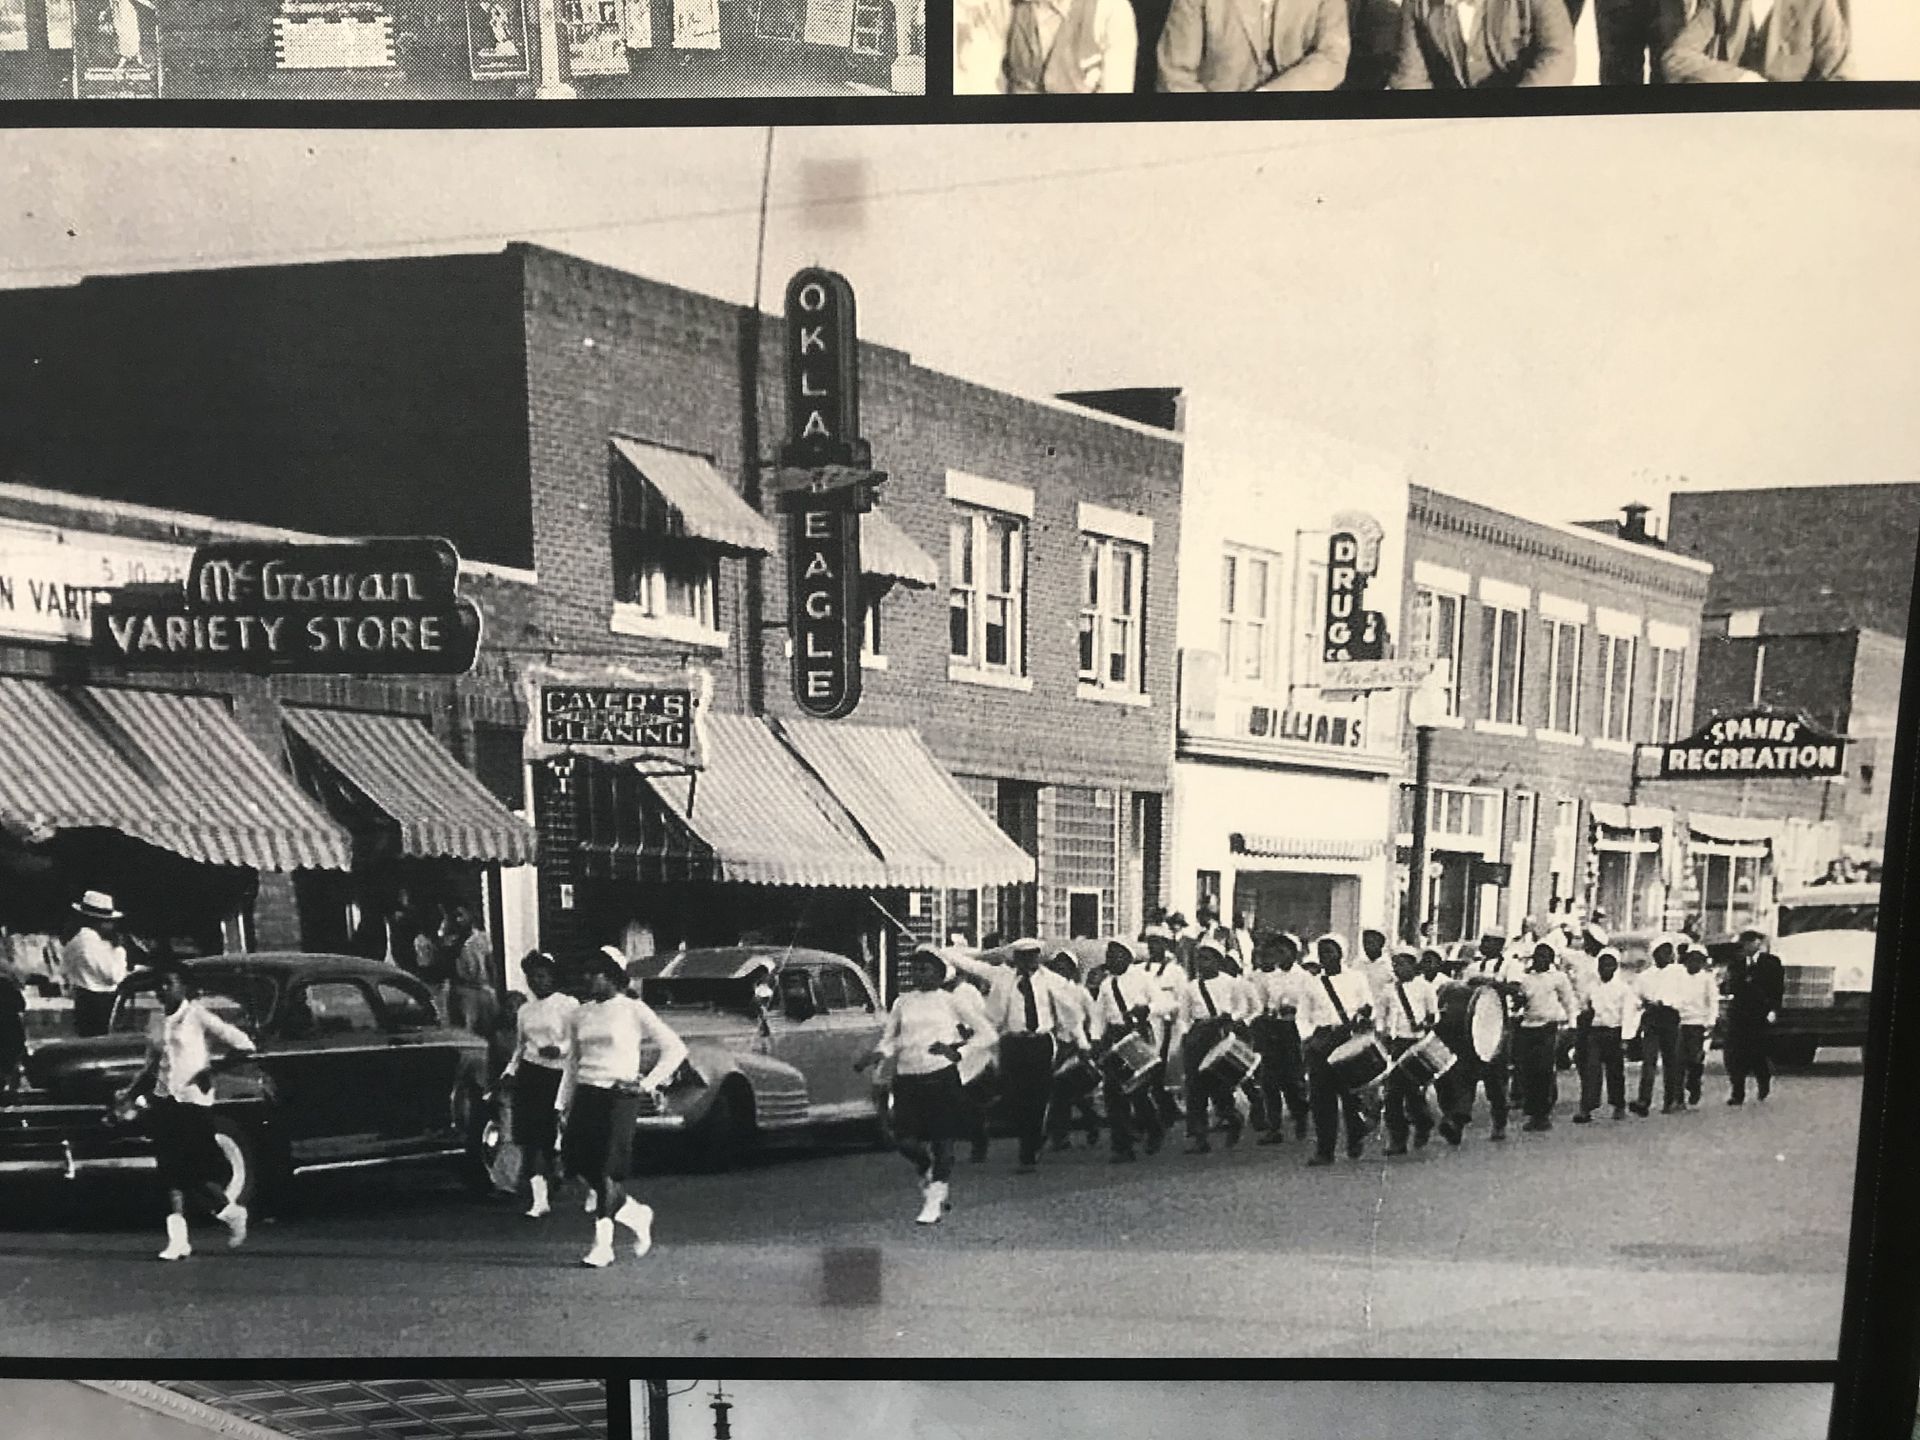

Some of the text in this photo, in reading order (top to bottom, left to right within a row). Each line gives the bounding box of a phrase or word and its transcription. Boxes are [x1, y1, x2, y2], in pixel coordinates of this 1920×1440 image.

[799, 283, 834, 698] OKLA EAGLE
[1327, 540, 1357, 645] DRUG
[107, 615, 441, 655] VARIETY STORE
[1667, 744, 1837, 771] RECREATION
